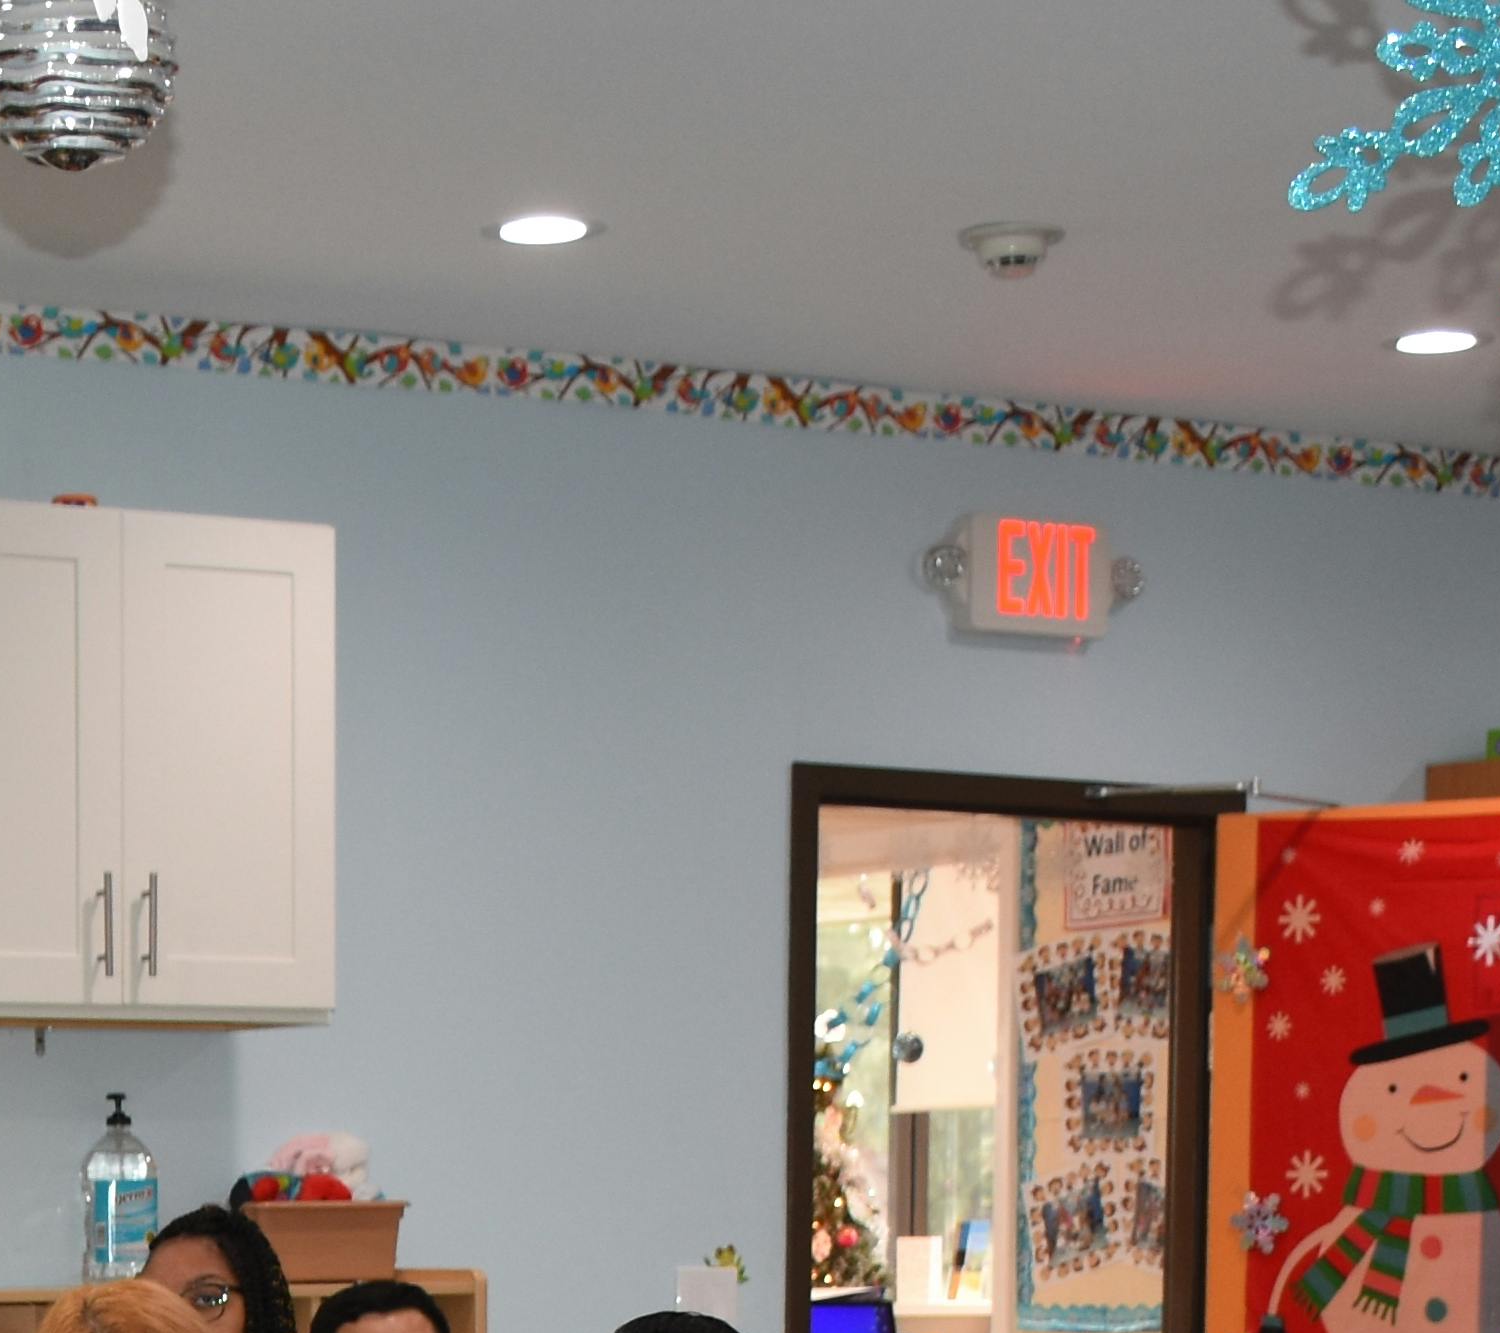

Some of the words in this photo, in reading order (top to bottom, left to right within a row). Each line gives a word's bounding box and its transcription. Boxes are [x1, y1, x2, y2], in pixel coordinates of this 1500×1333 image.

[996, 518, 1097, 621] EXIT
[1083, 829, 1126, 858] Wall
[1129, 825, 1149, 853] of
